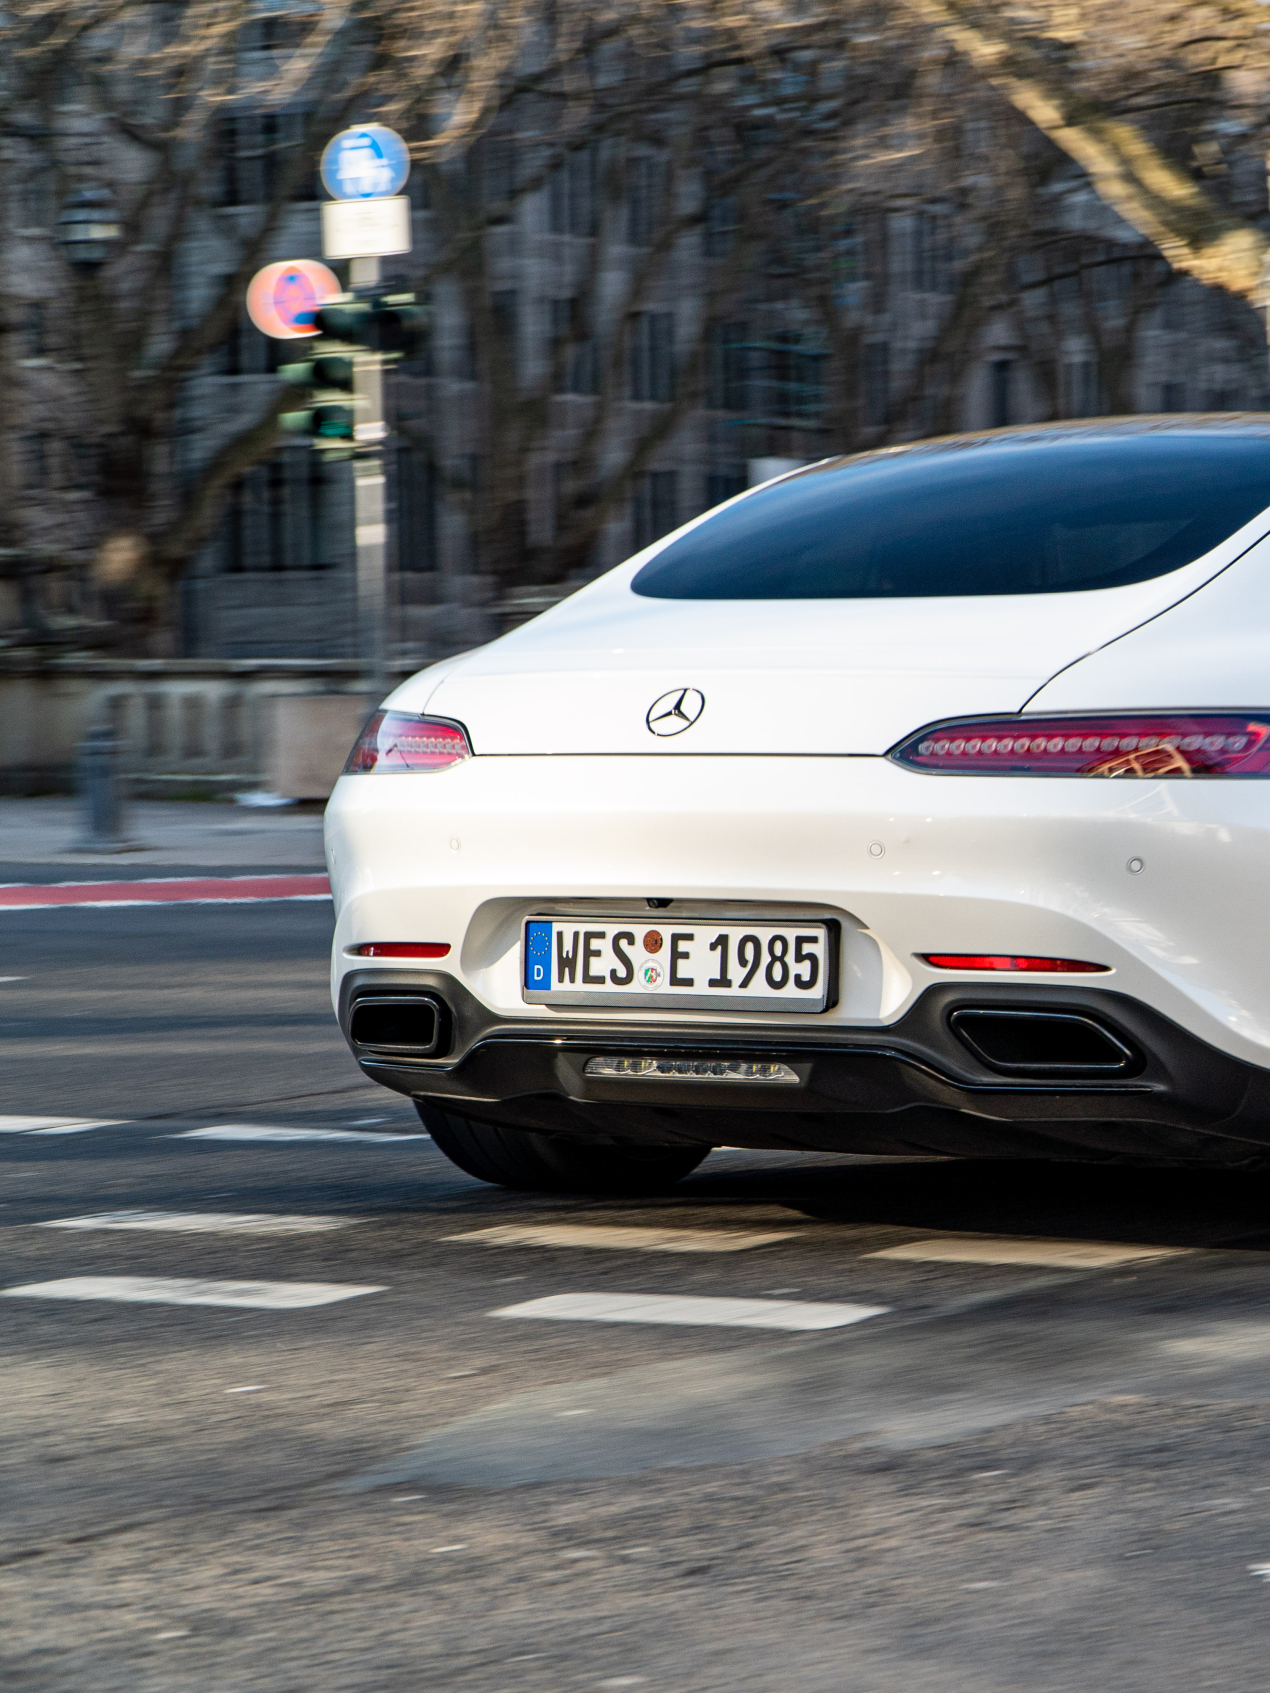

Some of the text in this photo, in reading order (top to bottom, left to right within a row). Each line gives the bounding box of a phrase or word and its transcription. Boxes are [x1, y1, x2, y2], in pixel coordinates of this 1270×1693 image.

[533, 964, 544, 981] D
[556, 930, 820, 990] WES E 1985
